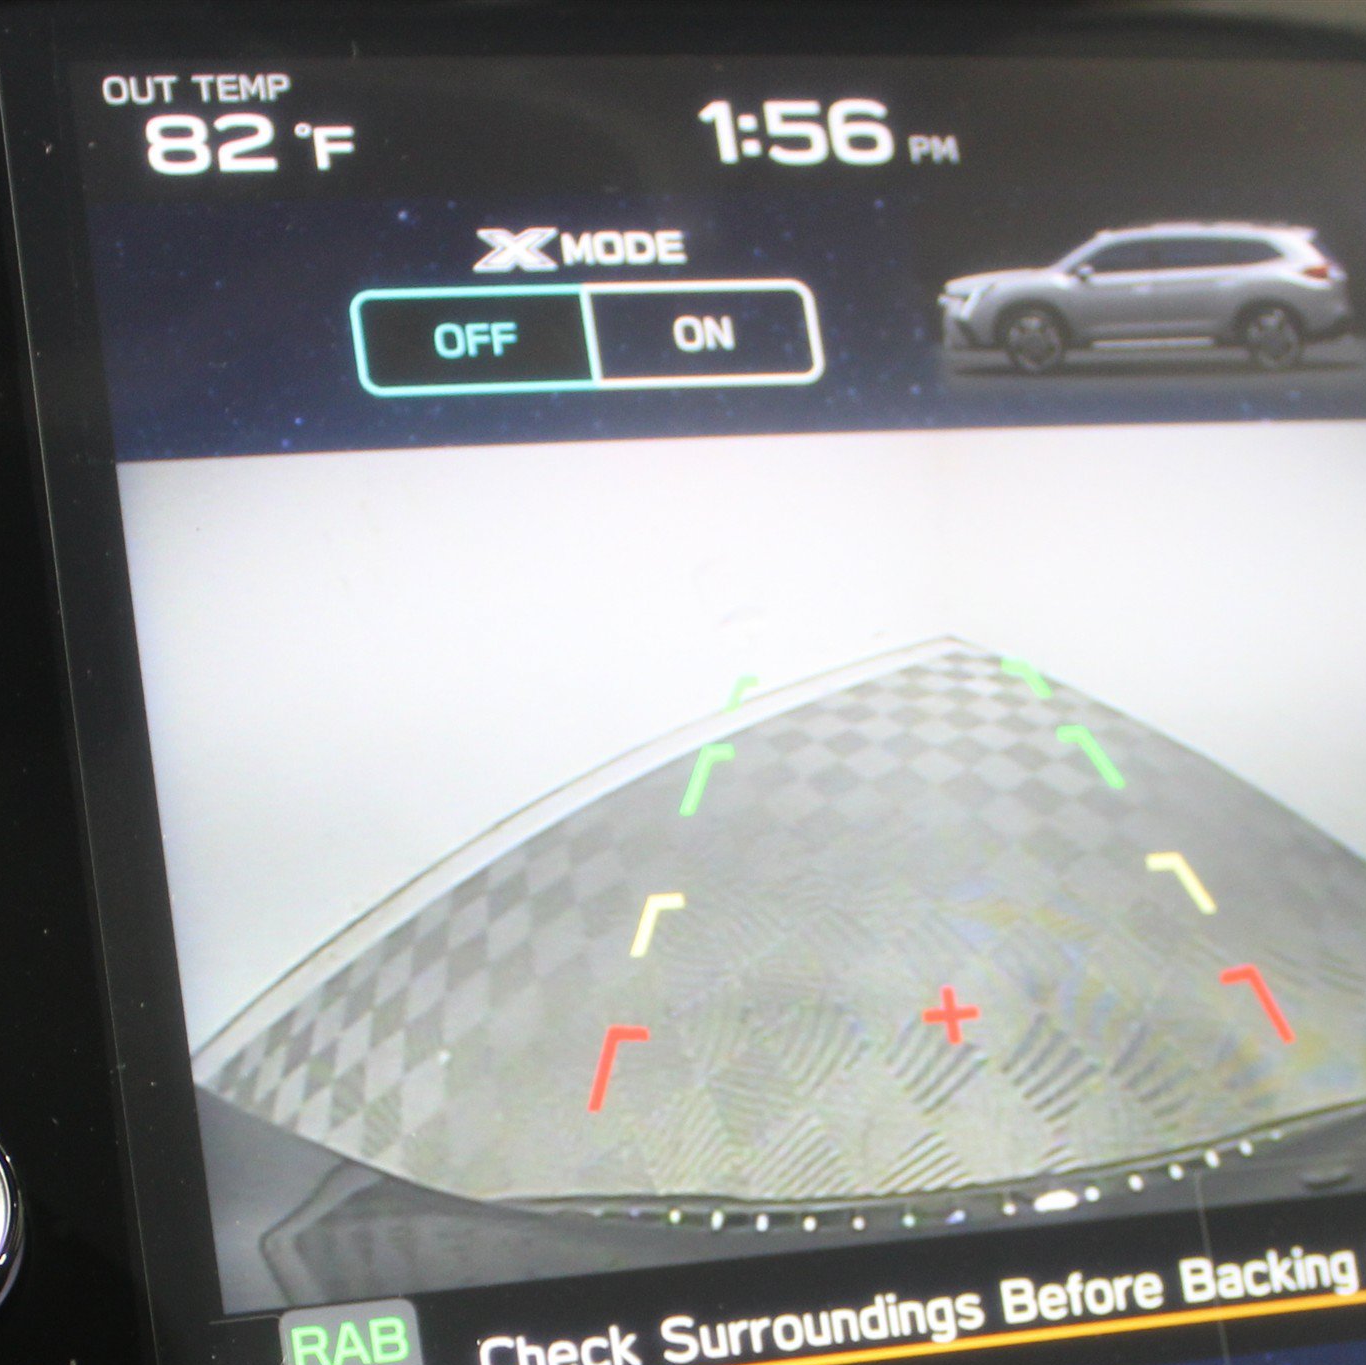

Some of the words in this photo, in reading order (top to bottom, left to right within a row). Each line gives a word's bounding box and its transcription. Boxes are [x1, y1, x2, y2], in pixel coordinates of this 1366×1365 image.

[102, 75, 177, 105] OUT
[192, 73, 290, 102] TEMP
[145, 112, 278, 175] 82
[699, 98, 894, 165] 1:56
[909, 135, 958, 161] PM
[561, 230, 686, 265] MODE
[434, 322, 517, 359] OFF
[673, 315, 734, 352] ON
[659, 1292, 986, 1365] Surroundings
[999, 1270, 1165, 1325] Before
[1178, 1245, 1360, 1302] Backing
